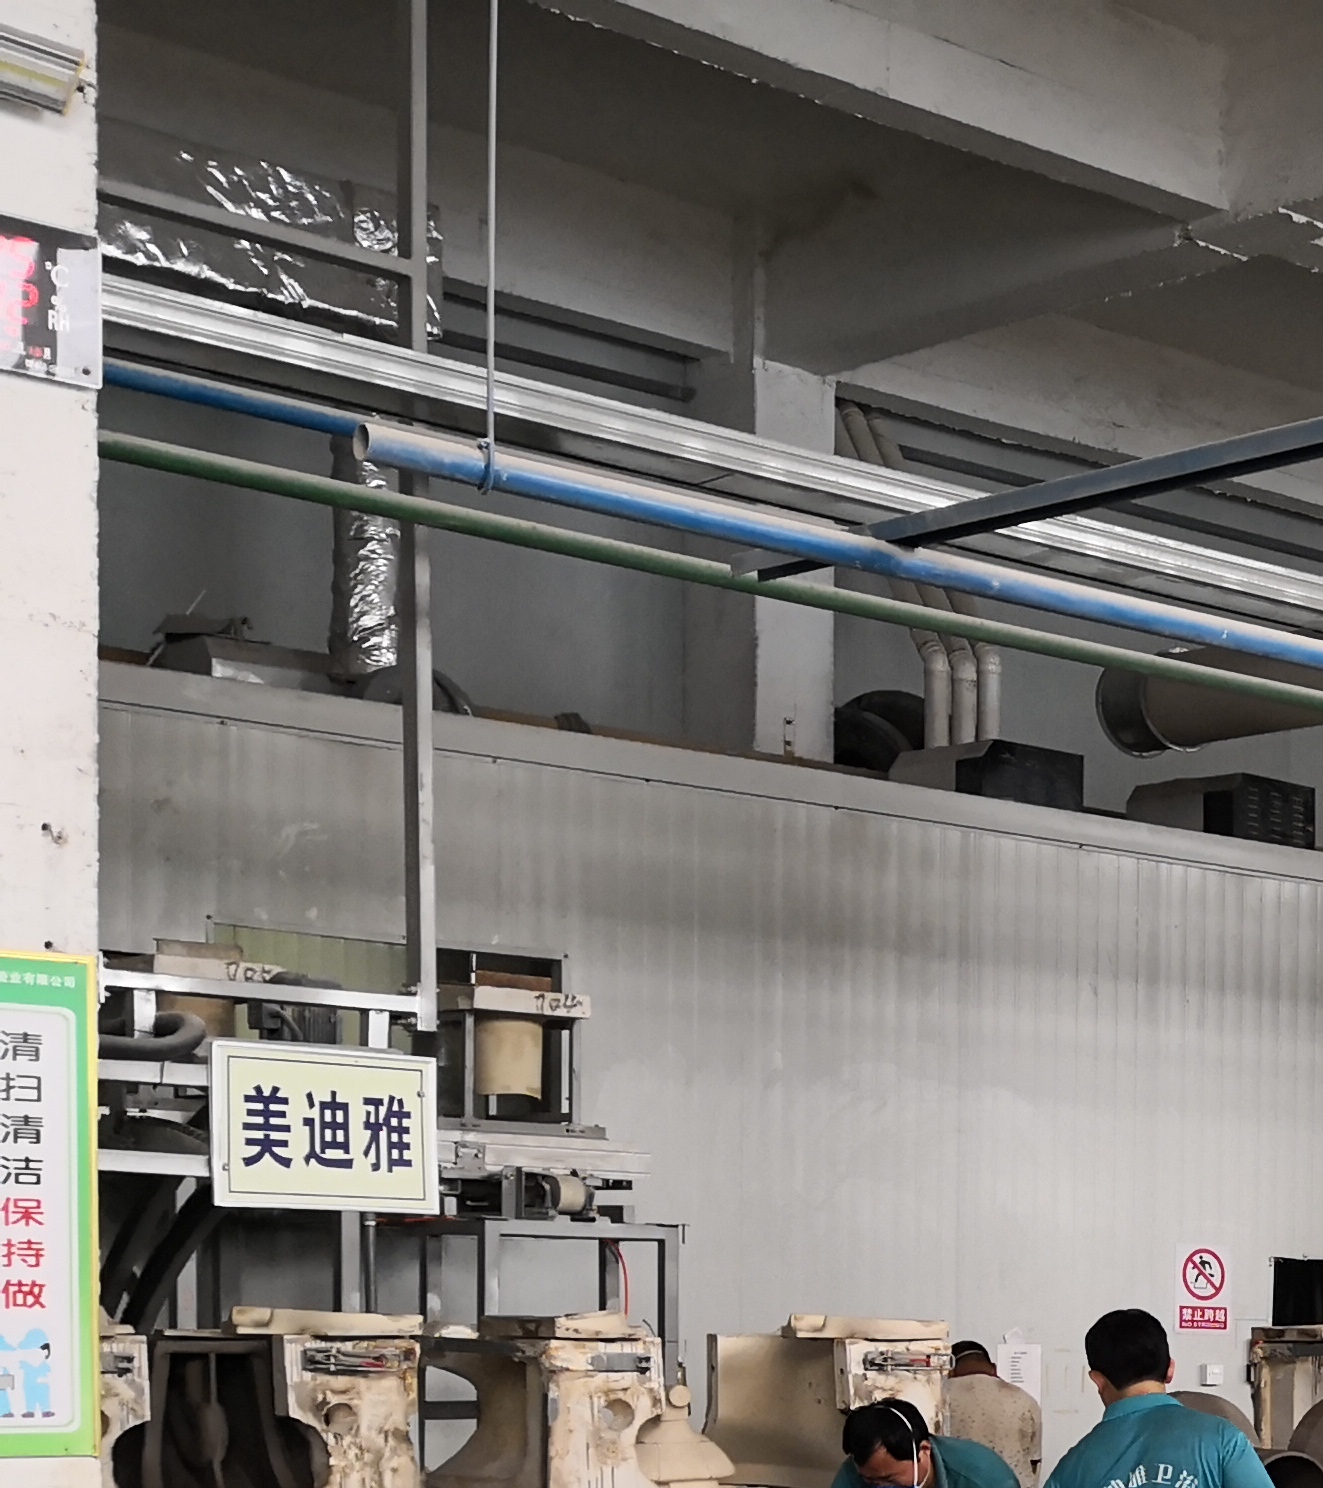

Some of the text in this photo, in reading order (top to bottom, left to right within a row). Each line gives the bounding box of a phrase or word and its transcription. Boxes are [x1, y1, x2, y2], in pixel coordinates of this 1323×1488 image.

[0, 1030, 46, 1309] 清扫清洁保持做
[241, 1084, 413, 1173] 美迪雅
